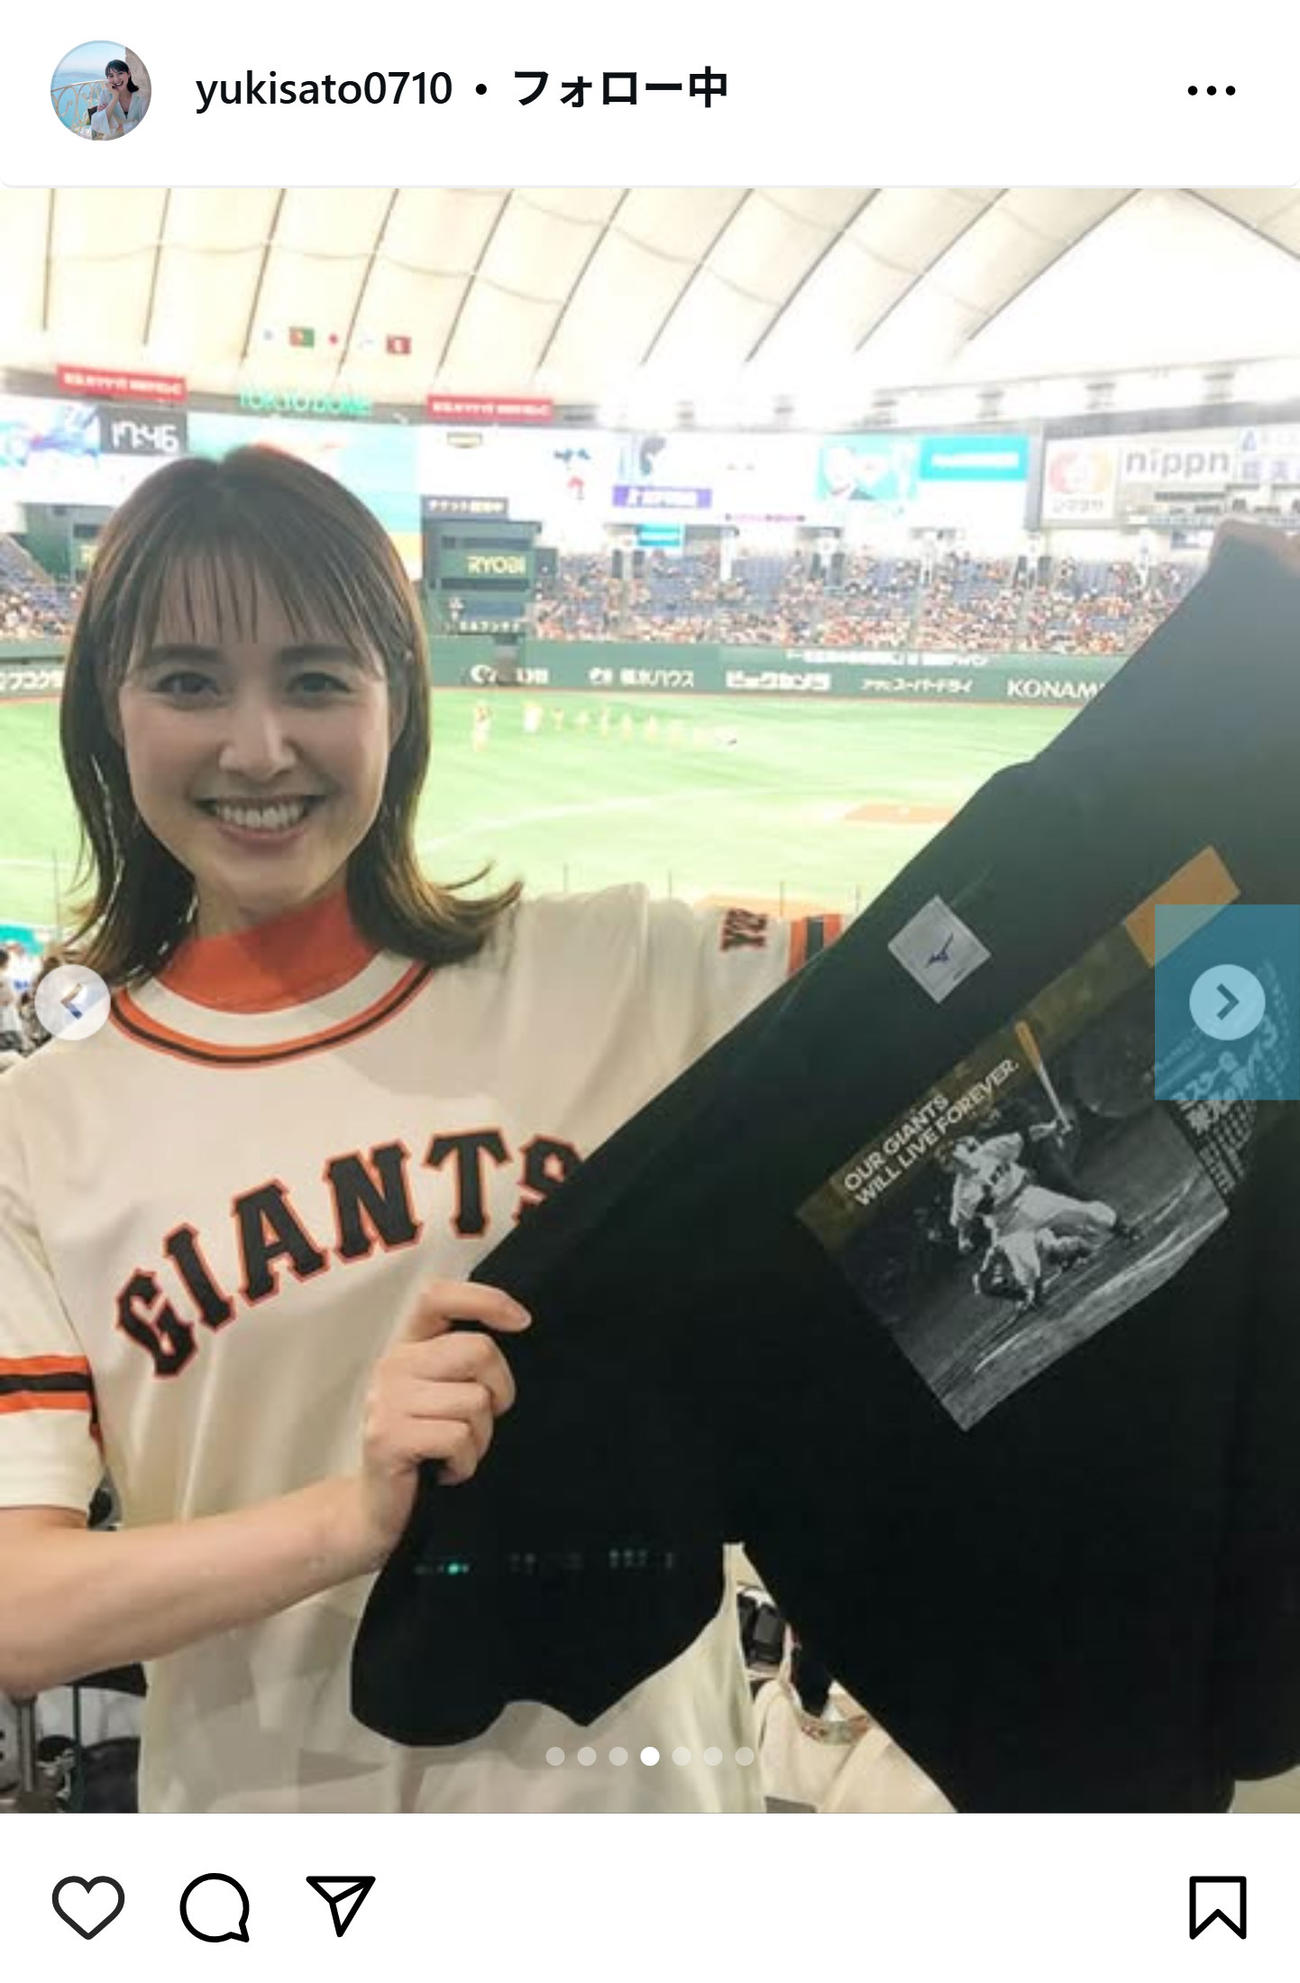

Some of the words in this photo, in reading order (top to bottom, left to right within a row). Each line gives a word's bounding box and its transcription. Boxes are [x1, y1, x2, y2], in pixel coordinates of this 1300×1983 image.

[1126, 447, 1230, 478] nippn
[467, 555, 526, 575] RYOBI
[1006, 677, 1105, 700] KONAM
[844, 1151, 887, 1191] OUR
[882, 1093, 949, 1155] GIANTS
[854, 1166, 902, 1206] WILL
[898, 1127, 940, 1169] LIVE
[934, 1058, 1020, 1135] FOREVER.
